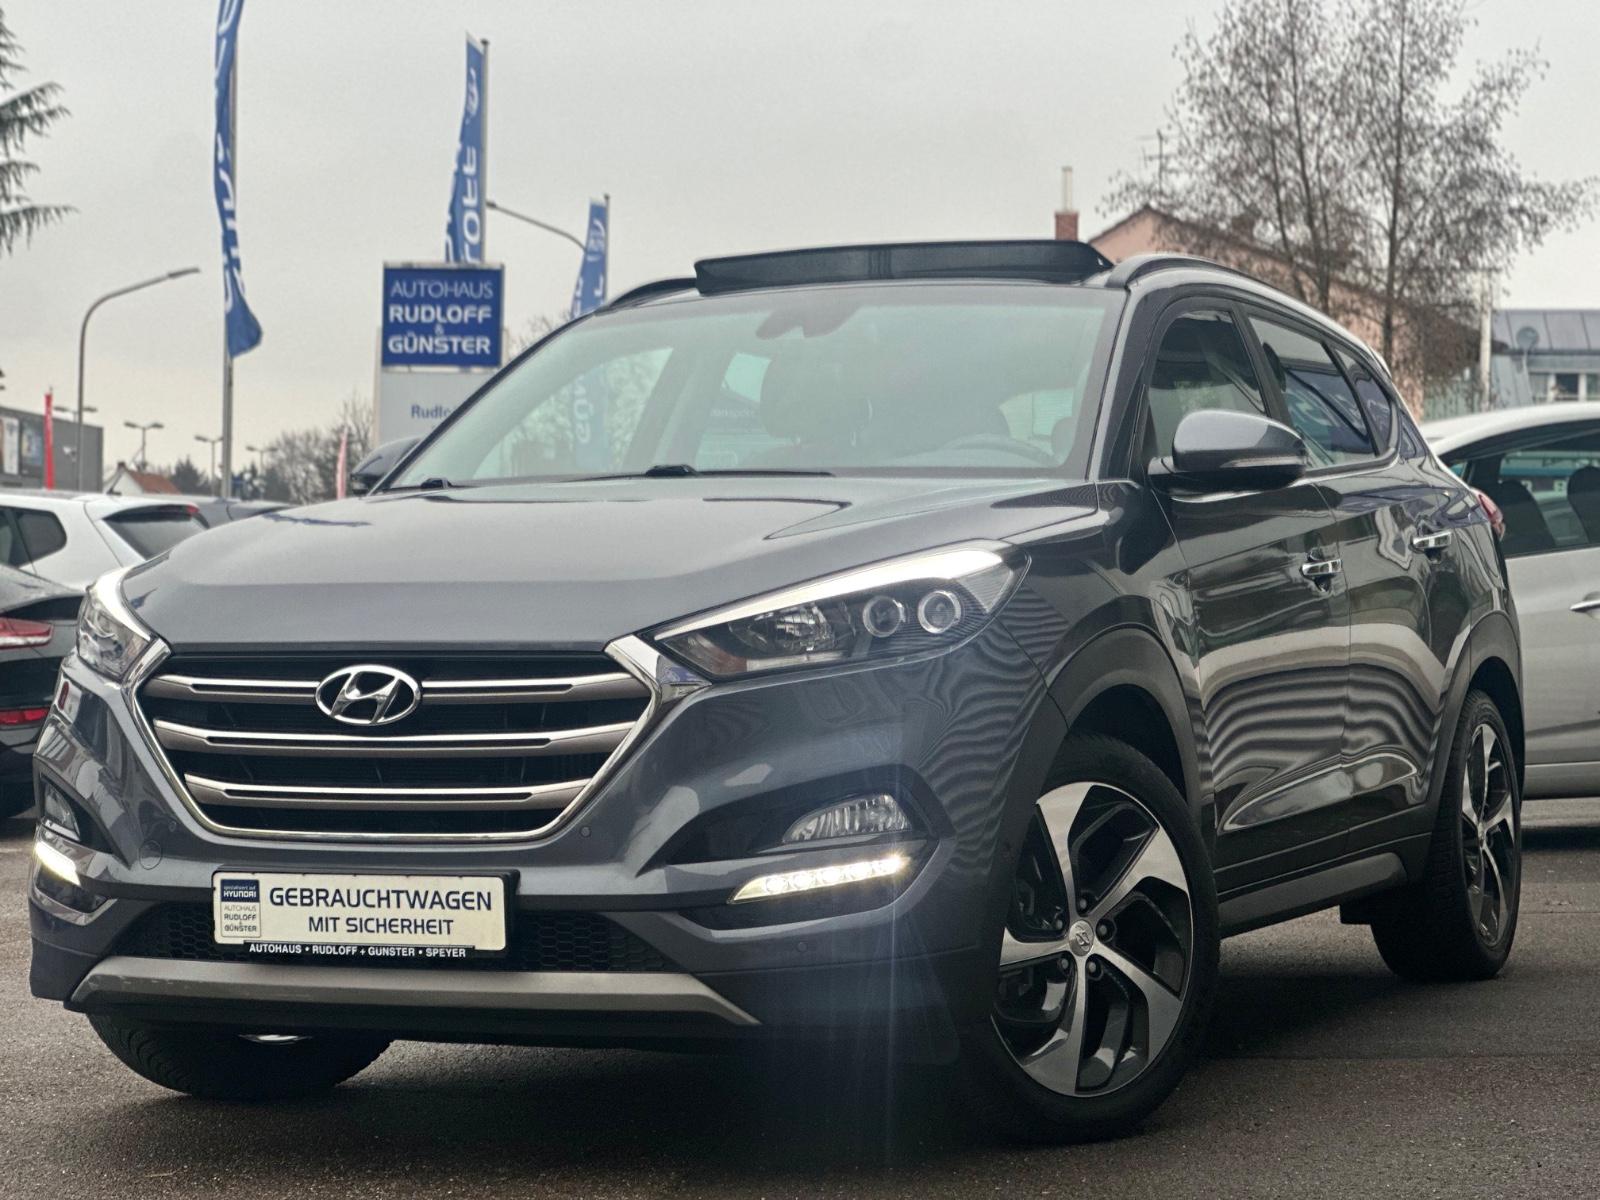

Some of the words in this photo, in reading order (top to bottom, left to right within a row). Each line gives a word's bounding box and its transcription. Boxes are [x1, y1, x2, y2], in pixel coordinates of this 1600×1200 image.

[390, 280, 494, 299] AUTOHAUS
[388, 304, 492, 323] RUDLOFF
[387, 331, 491, 354] GÜNSTER
[223, 890, 257, 898] HYUNDAI
[269, 887, 492, 911] GEBRAUCHTWAGEN
[223, 904, 257, 912] AUTOHAUS
[223, 913, 257, 921] RUDLOFF
[308, 916, 340, 933] MIT
[346, 917, 454, 935] SICHERHEIT
[249, 943, 302, 954] AUTOHAUS
[312, 945, 358, 956] RUDLOFF
[367, 946, 416, 957] GUNSTER
[425, 947, 467, 958] SPEYER
